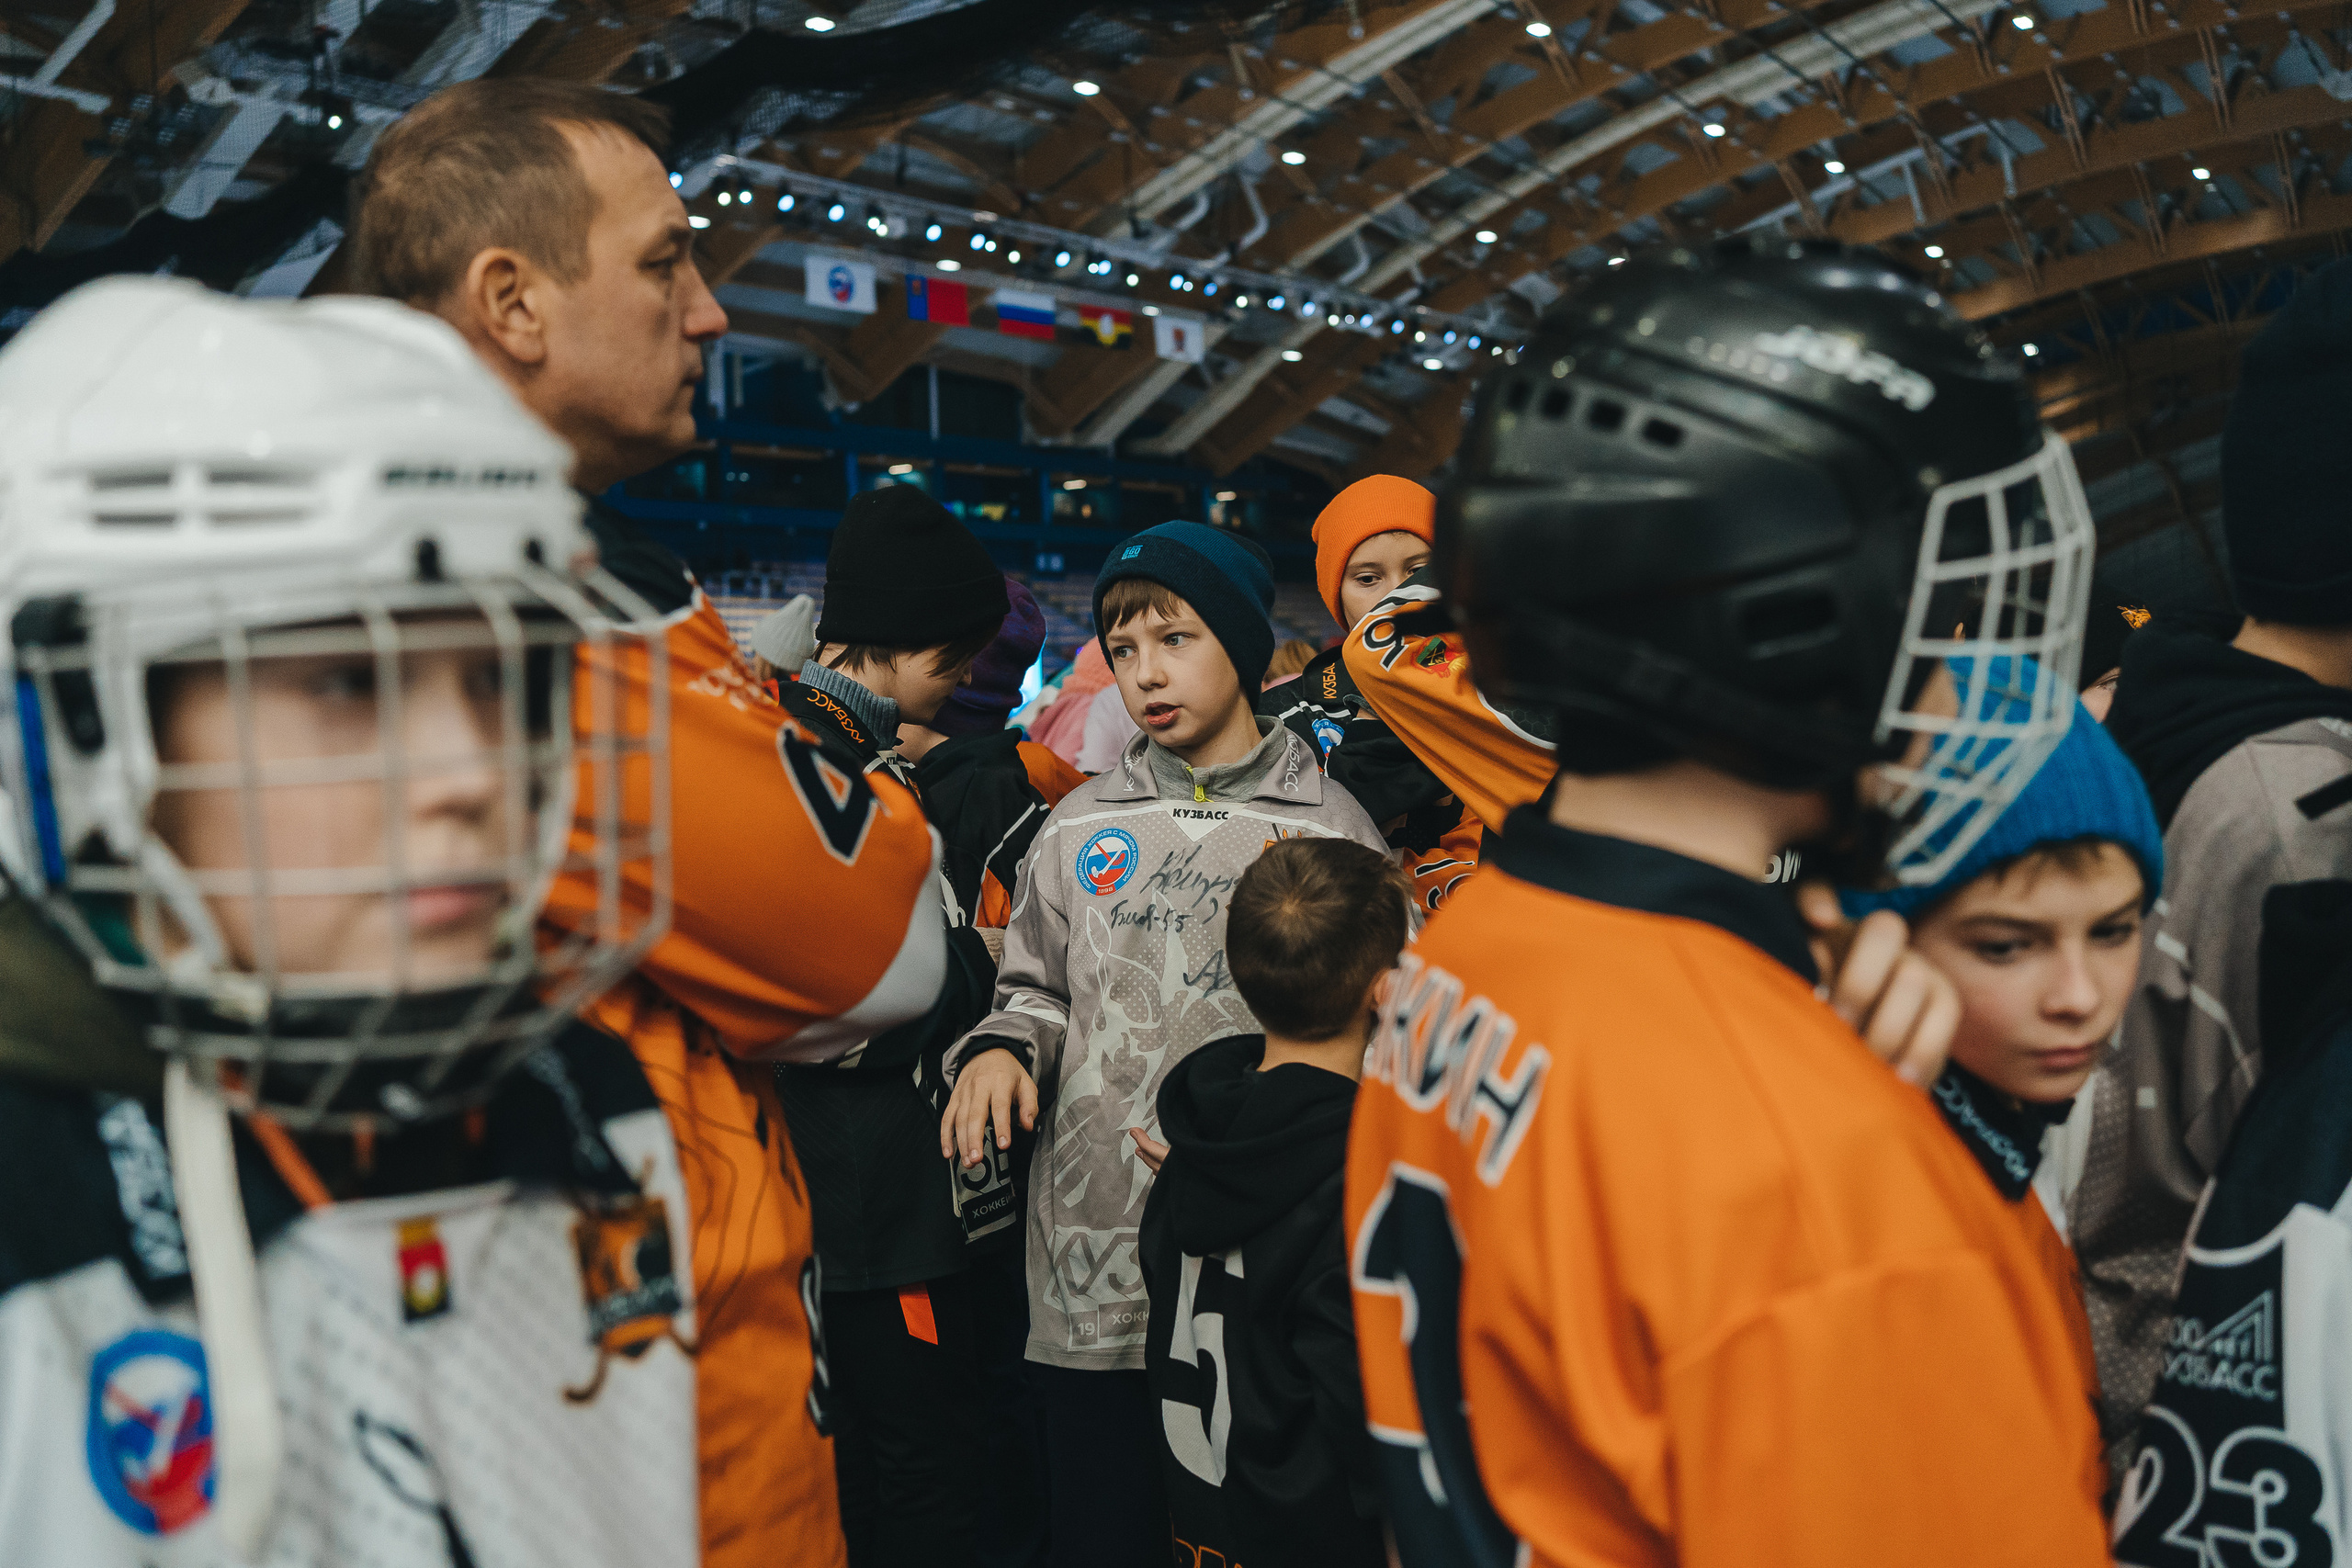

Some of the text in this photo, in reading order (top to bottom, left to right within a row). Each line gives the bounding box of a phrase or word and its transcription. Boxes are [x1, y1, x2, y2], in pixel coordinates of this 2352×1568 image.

[807, 688, 865, 744] КУЗБАСС
[1172, 808, 1229, 820] КУЗБАСС
[1088, 829, 1112, 848] ХОККЕЯ
[1118, 830, 1136, 852] МЯЧОМ
[1078, 847, 1091, 889] ФЕДЕРАЦИЯ
[1123, 852, 1137, 882] РОССИИ
[1077, 1322, 1096, 1336] 19
[2113, 1405, 2338, 1568] 23
